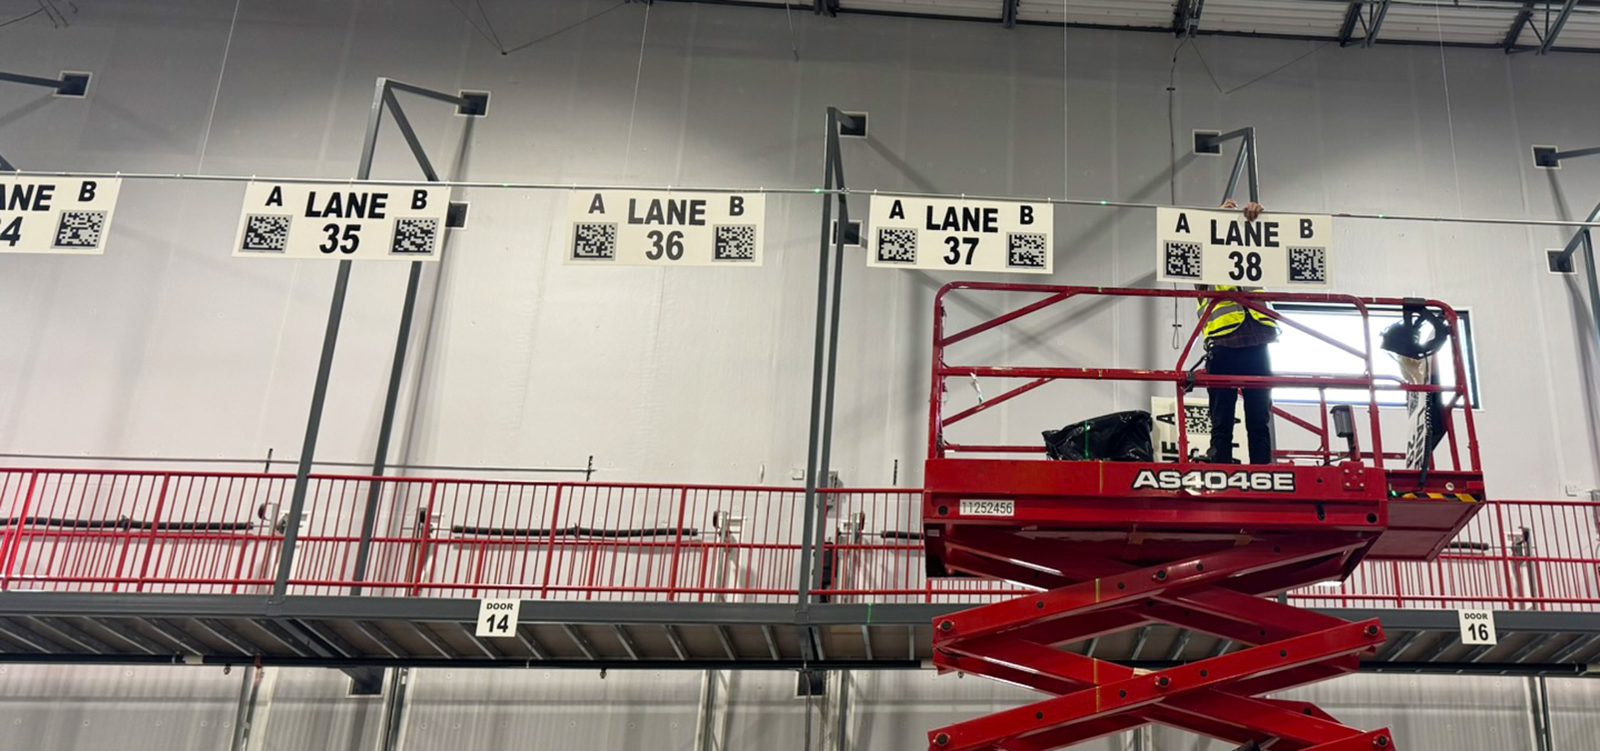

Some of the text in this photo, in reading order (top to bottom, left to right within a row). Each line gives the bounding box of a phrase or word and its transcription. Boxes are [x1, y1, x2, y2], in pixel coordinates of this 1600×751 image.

[0, 181, 97, 211] NE B
[265, 186, 428, 219] A LANE B
[588, 194, 745, 226] A LANE B
[0, 216, 23, 246] 4
[889, 200, 1034, 233] A LANE B
[1175, 212, 1314, 248] A LANE B
[319, 223, 361, 254] 35
[645, 230, 684, 261] 36
[943, 236, 979, 266] 37
[1228, 251, 1263, 282] 38
[1156, 413, 1176, 426] A
[1132, 470, 1296, 492] AS4046E
[962, 502, 1013, 515] 11252456
[486, 614, 509, 633] 14
[1468, 623, 1489, 641] 16
